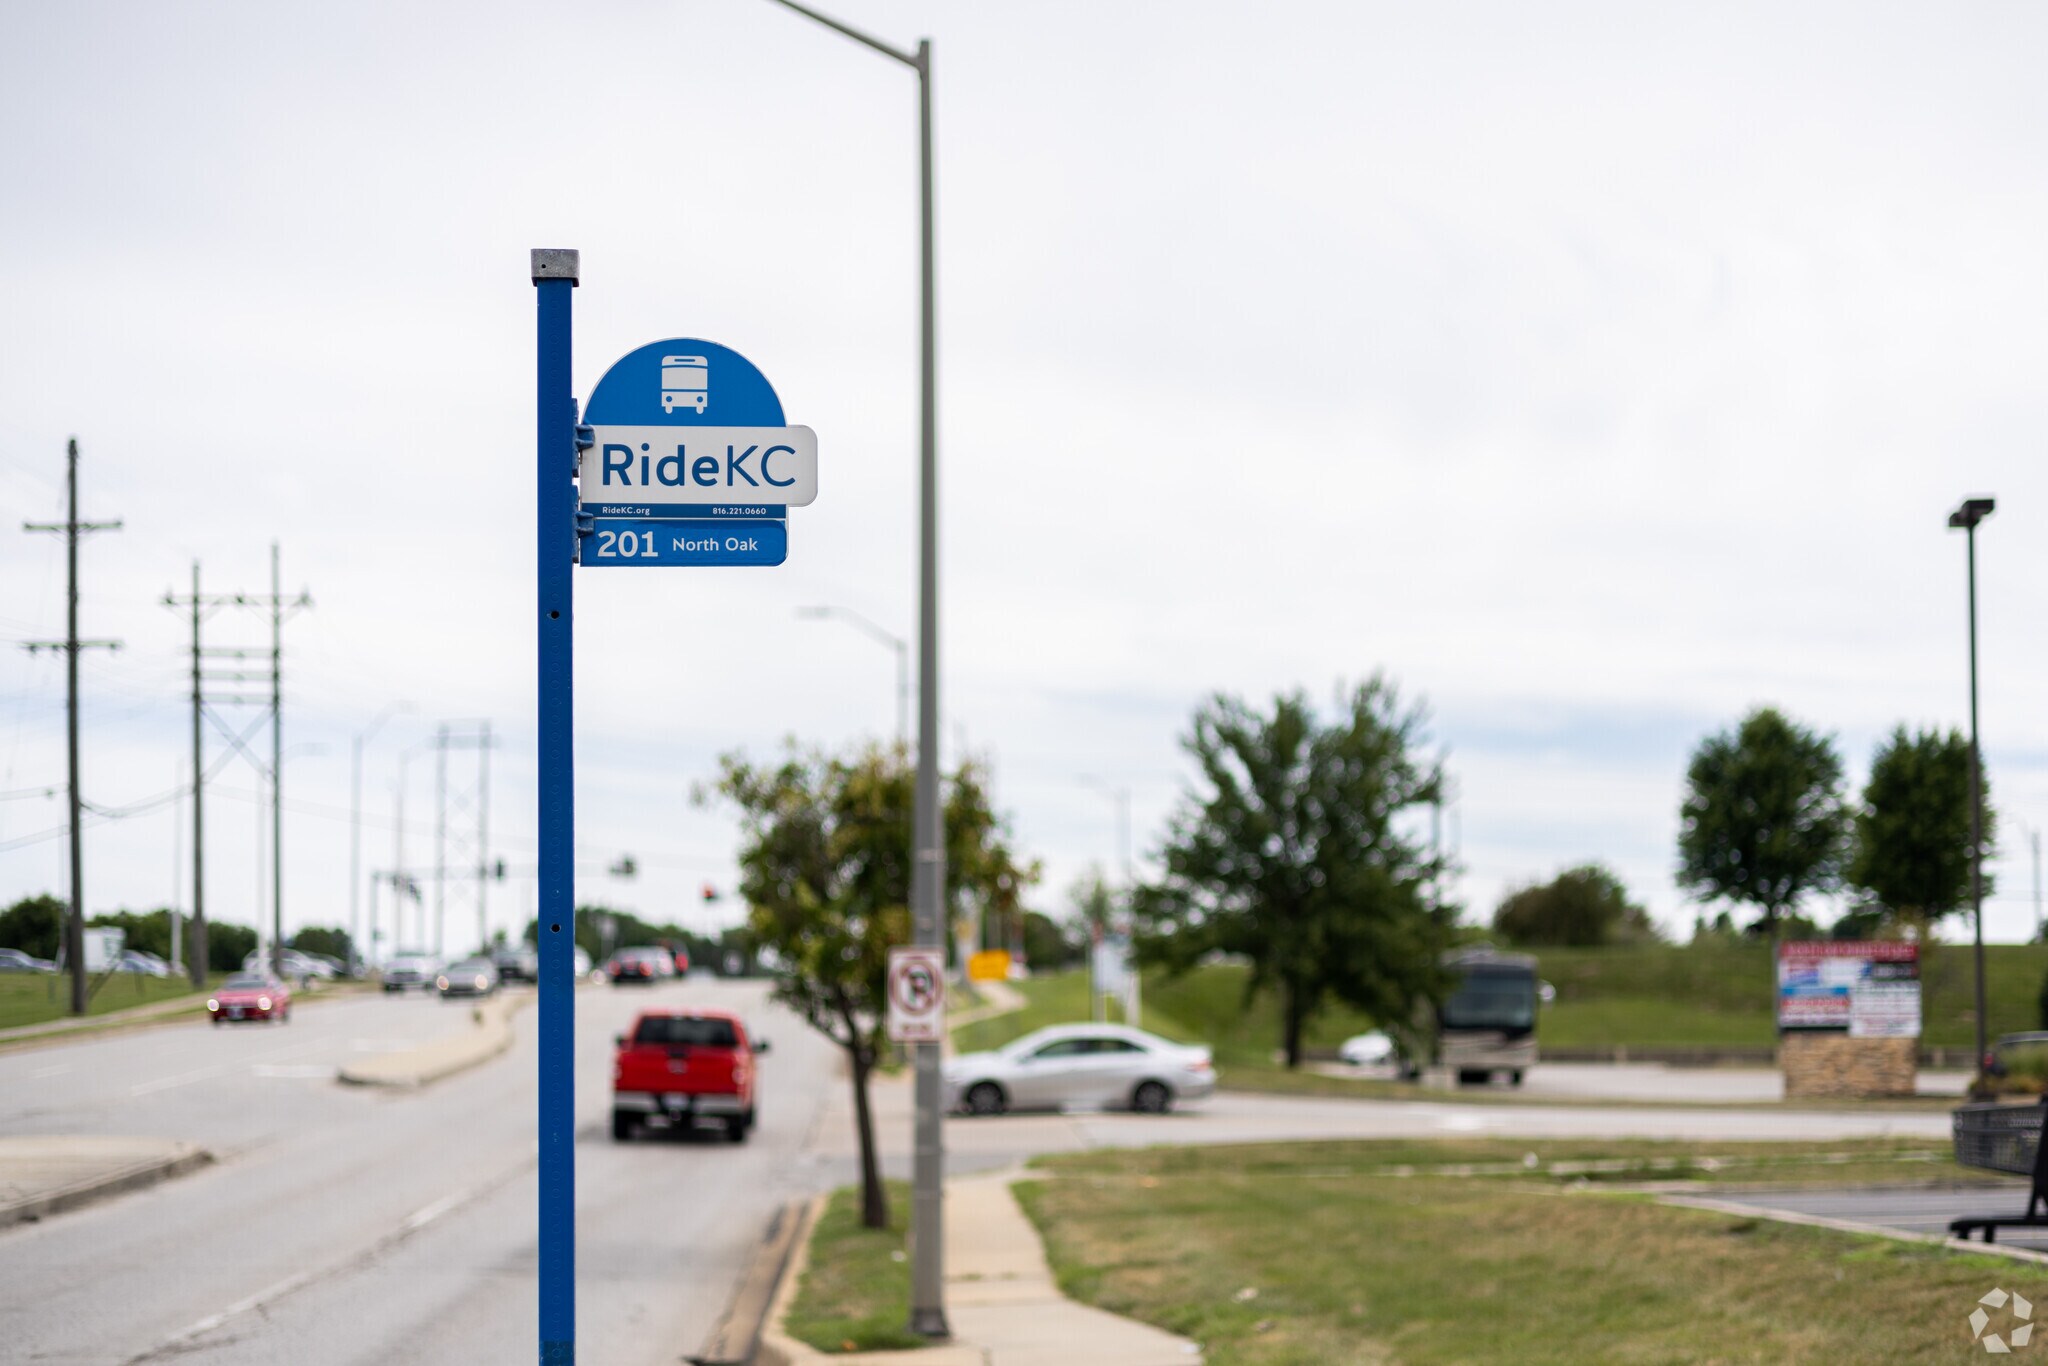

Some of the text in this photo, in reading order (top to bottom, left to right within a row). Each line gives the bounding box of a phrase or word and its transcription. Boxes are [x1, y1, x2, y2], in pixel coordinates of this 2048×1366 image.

[602, 443, 796, 487] RideKC
[602, 506, 650, 516] RideKC.org
[712, 507, 767, 516] 816.221.0660
[597, 530, 659, 558] 201
[672, 537, 758, 551] North Oak
